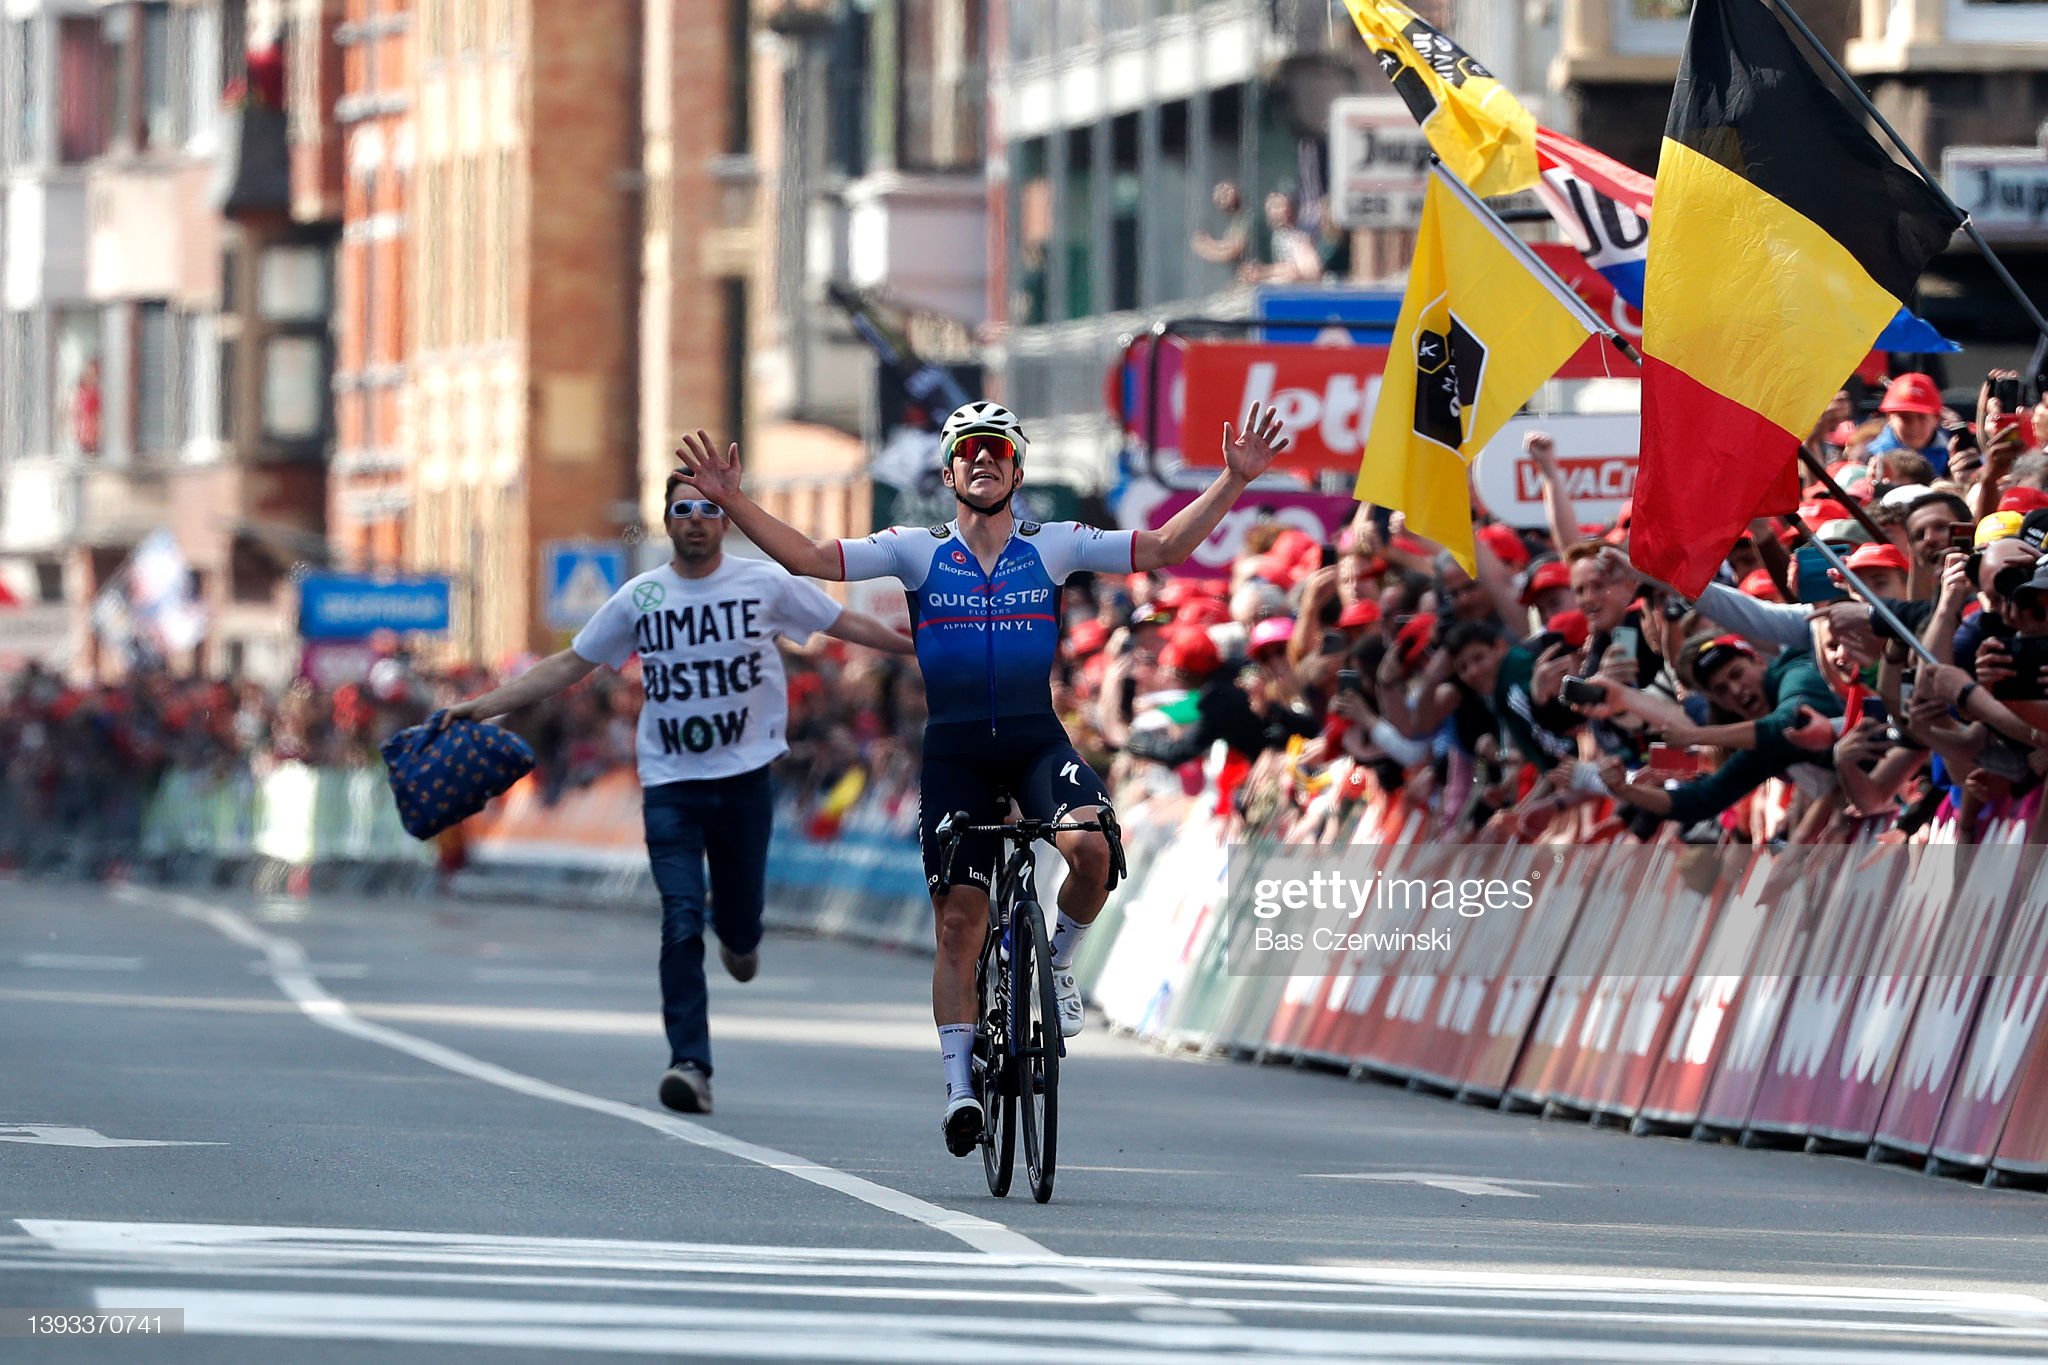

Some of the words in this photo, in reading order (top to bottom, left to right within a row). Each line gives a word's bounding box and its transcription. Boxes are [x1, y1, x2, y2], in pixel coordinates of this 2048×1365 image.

[938, 562, 979, 578] Ekopak
[928, 588, 1049, 608] QUICK-STEP
[658, 706, 748, 755] NOW
